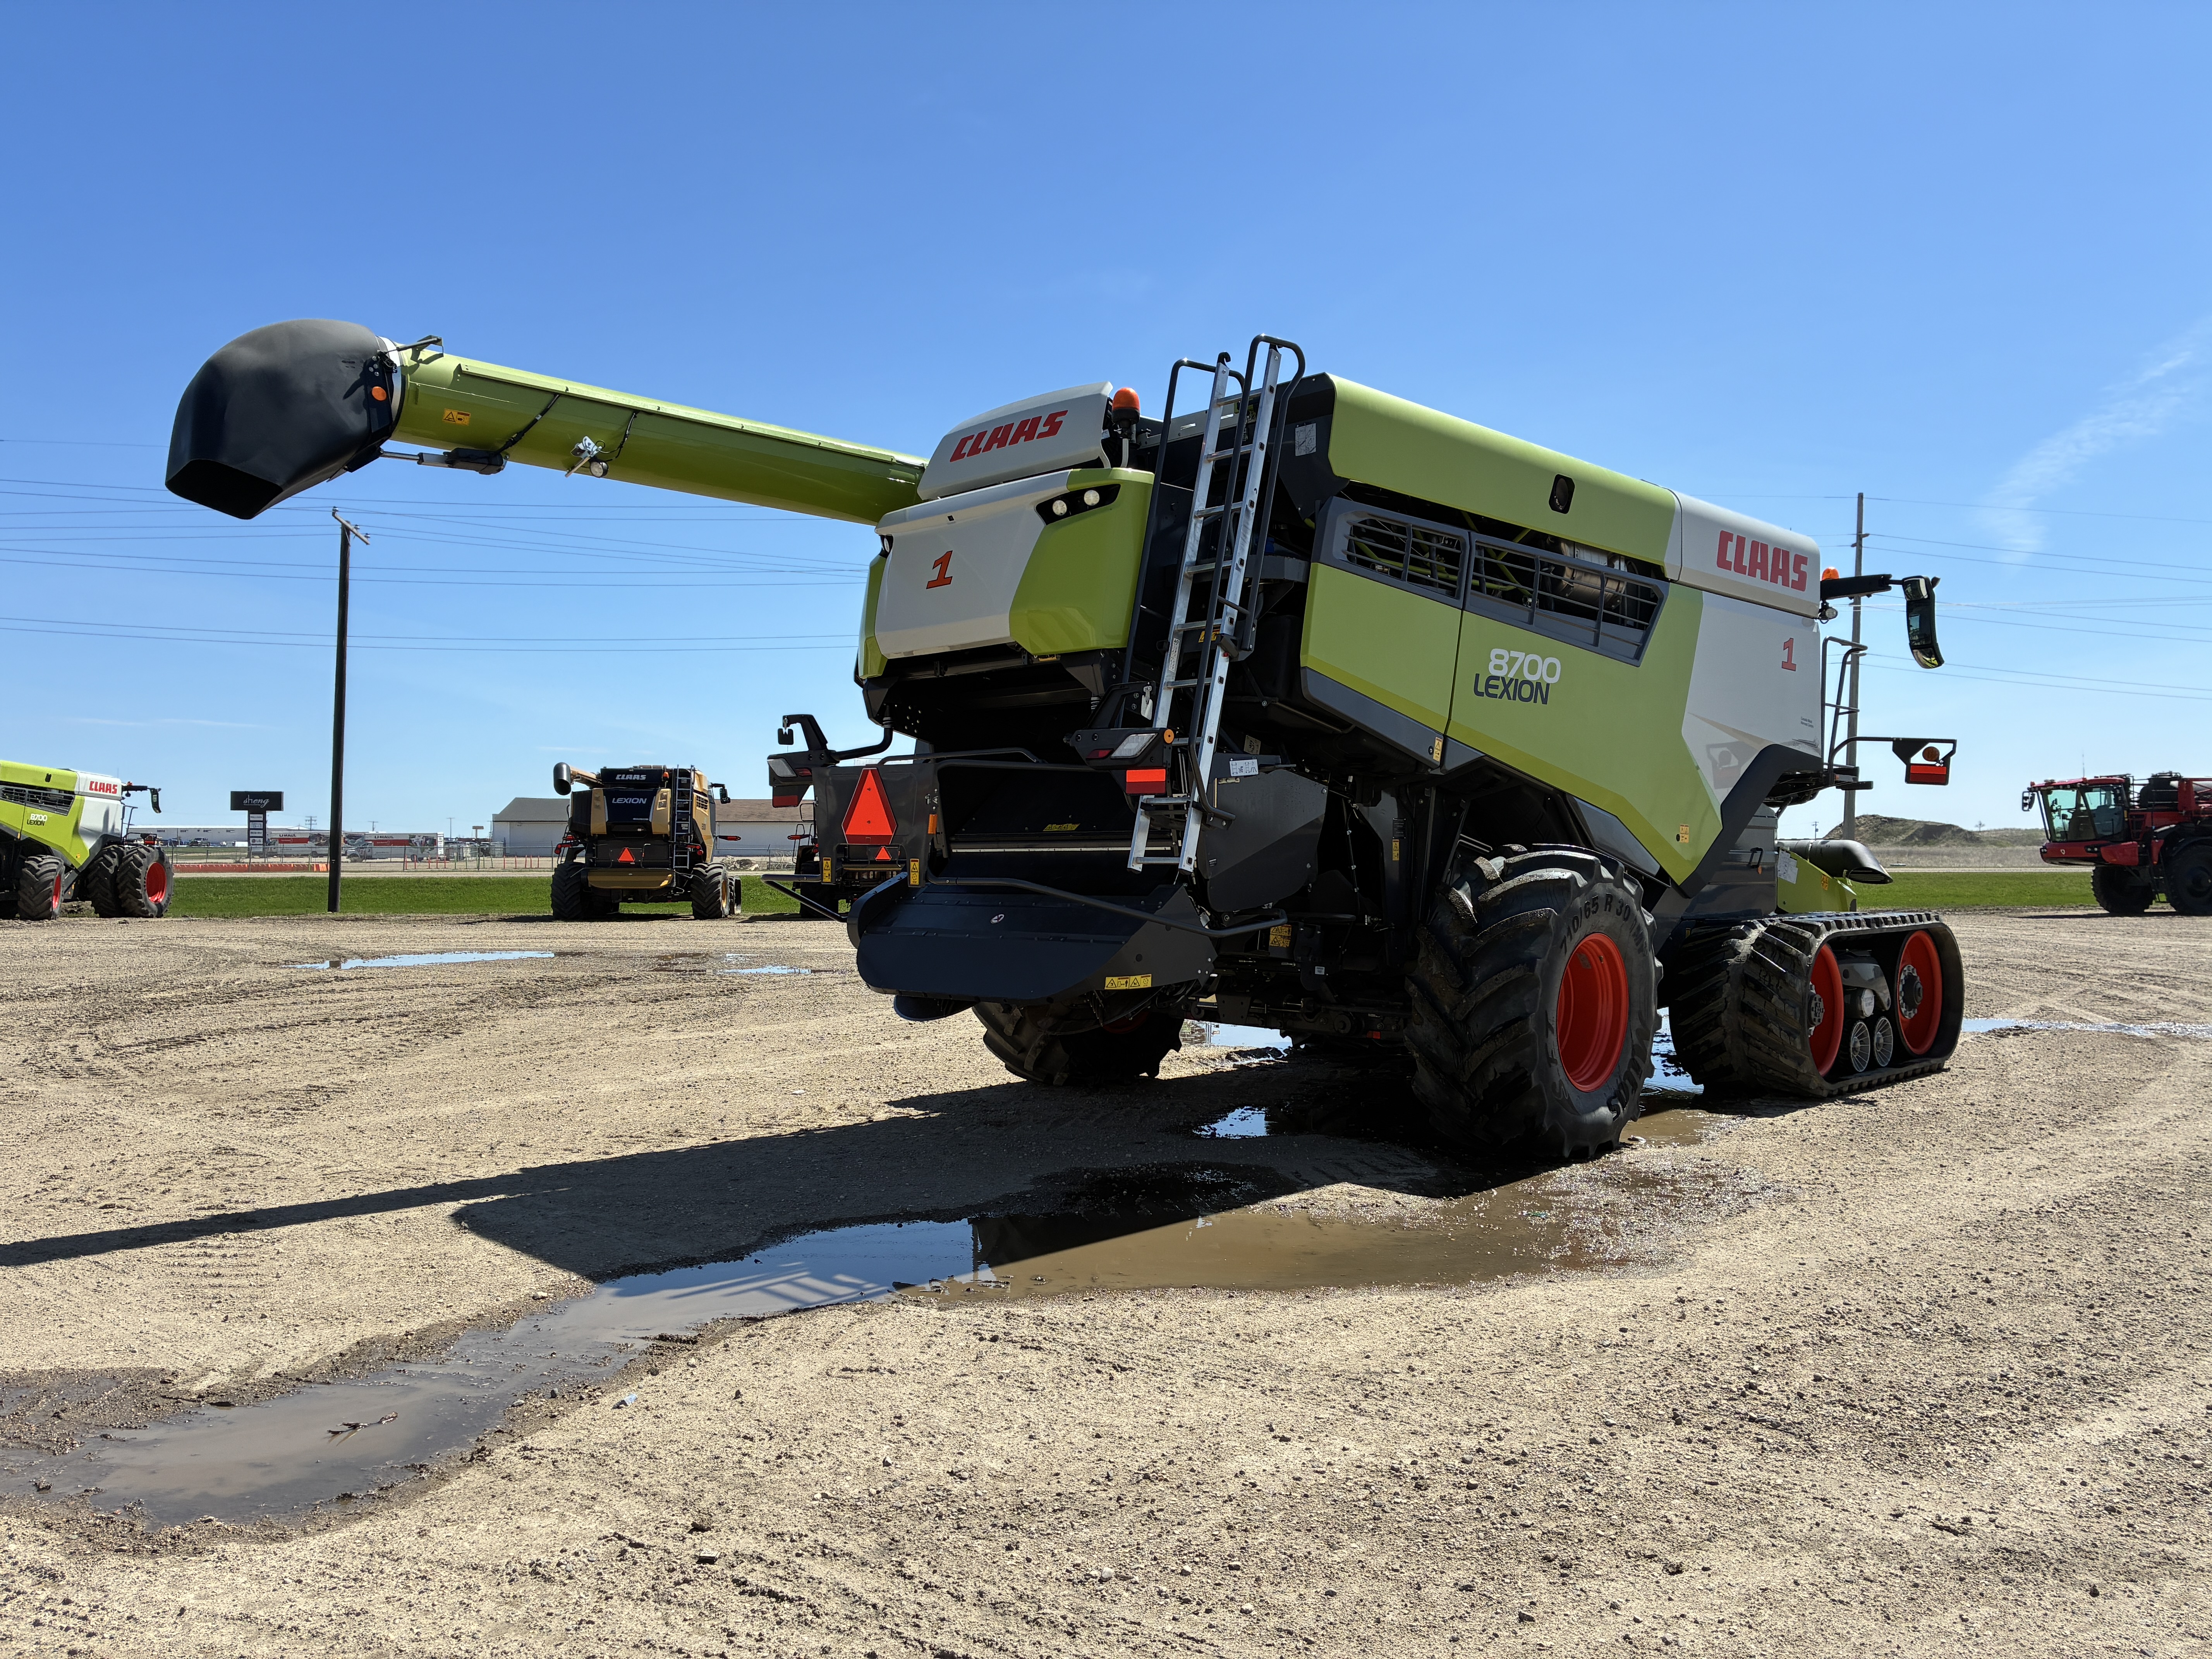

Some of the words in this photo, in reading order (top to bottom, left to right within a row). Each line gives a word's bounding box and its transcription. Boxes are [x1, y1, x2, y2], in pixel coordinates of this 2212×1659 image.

[950, 410, 1068, 463] CLAAS
[926, 550, 953, 589] 1
[1716, 530, 1808, 592] CLAAS
[1488, 648, 1561, 684] 8700
[1781, 637, 1796, 672] 1
[1474, 673, 1550, 705] LEXION
[89, 781, 118, 794] CLAAS
[30, 813, 48, 822] 8700
[1604, 893, 1613, 912] R
[1616, 898, 1630, 922] 30
